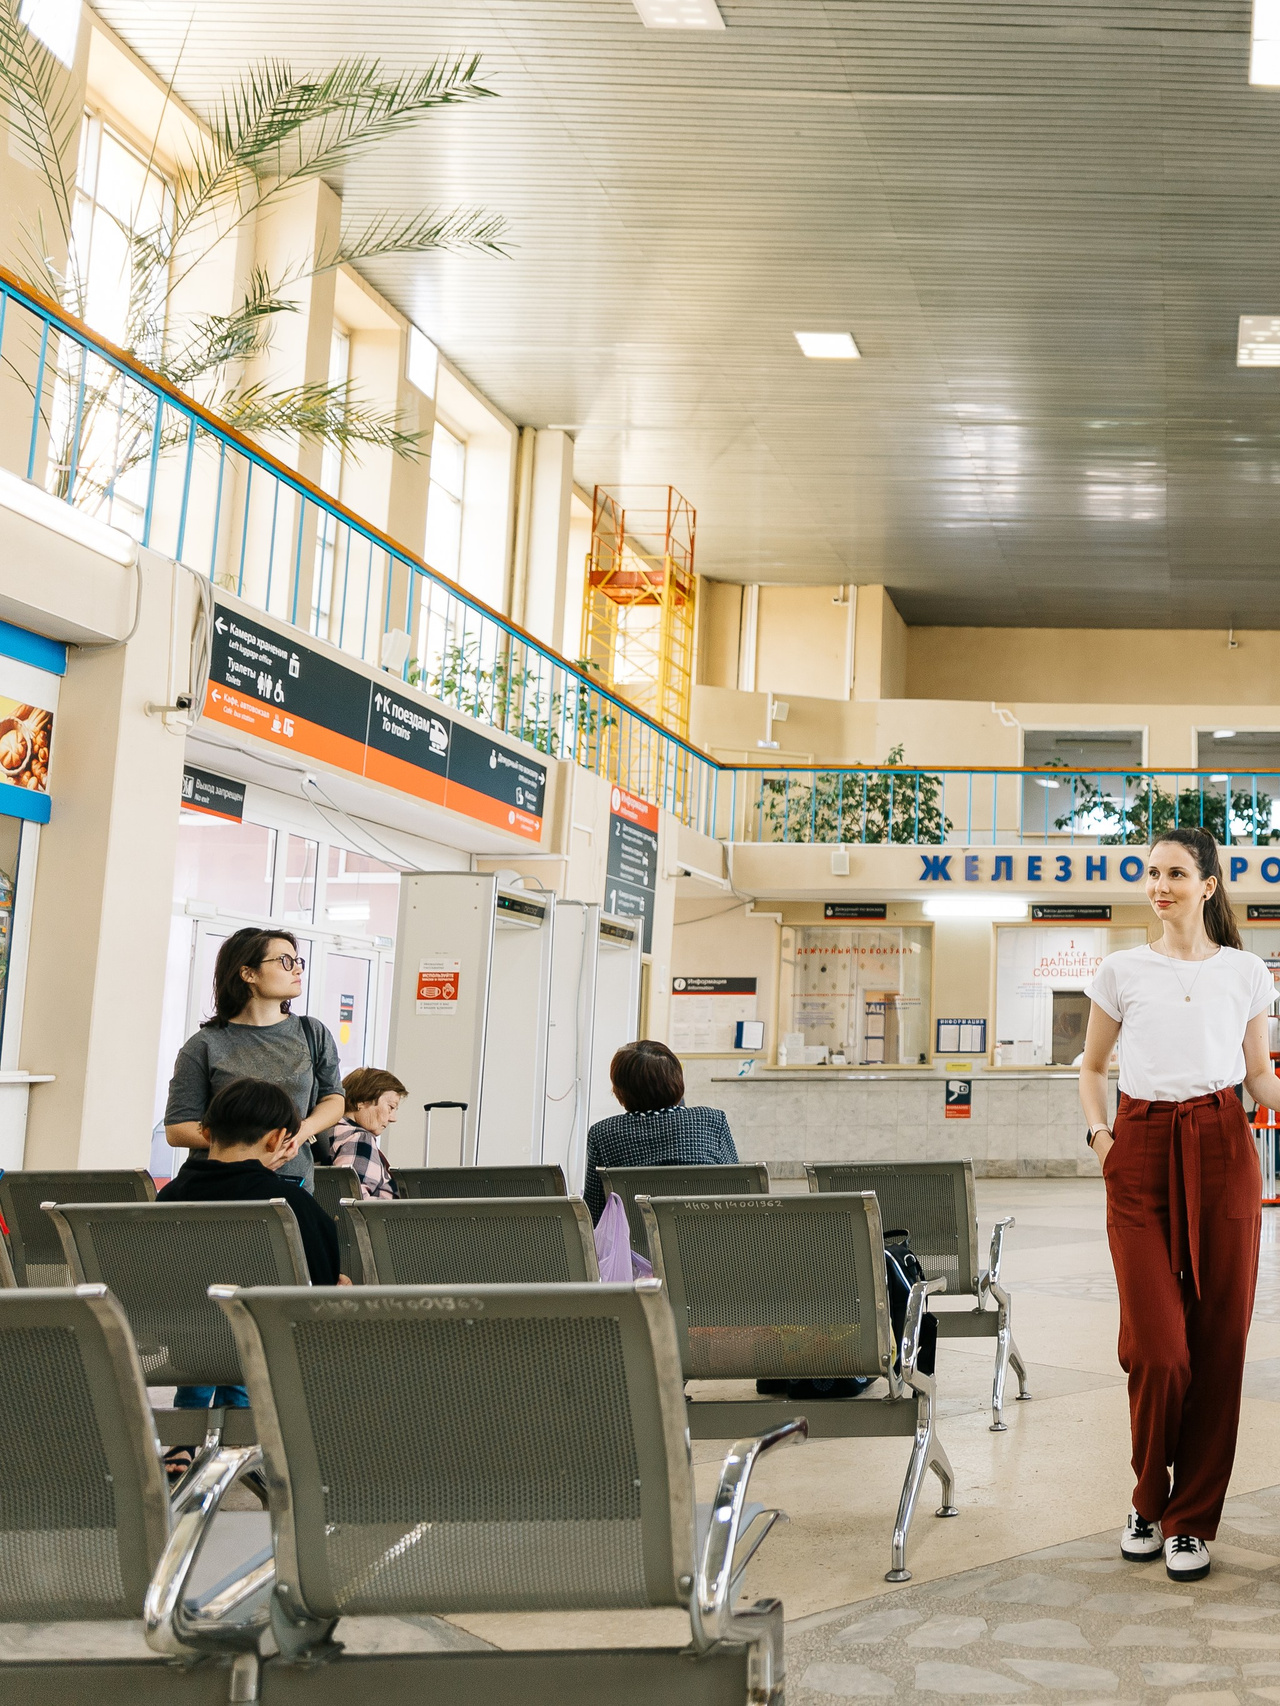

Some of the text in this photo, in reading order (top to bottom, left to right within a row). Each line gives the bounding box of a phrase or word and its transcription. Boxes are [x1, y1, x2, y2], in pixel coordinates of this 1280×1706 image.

[230, 622, 288, 660] Камера хранения
[228, 639, 273, 666] Left luggage office
[227, 655, 256, 680] Туалеты
[225, 672, 241, 687] Toilets
[382, 695, 430, 733] К поездам
[382, 717, 412, 741] To trains
[195, 778, 215, 795] Выход
[194, 793, 210, 804] No exit
[614, 821, 621, 837] 2
[610, 889, 617, 915] 1
[1105, 908, 1110, 919] 1
[797, 946, 914, 956] ДЕЖУРНЫЙ ПО ВОКЗАЛУ
[1070, 940, 1076, 949] 1
[1040, 957, 1104, 968] ДАЛЬНЕГО
[1033, 967, 1098, 978] СООБЩЕН
